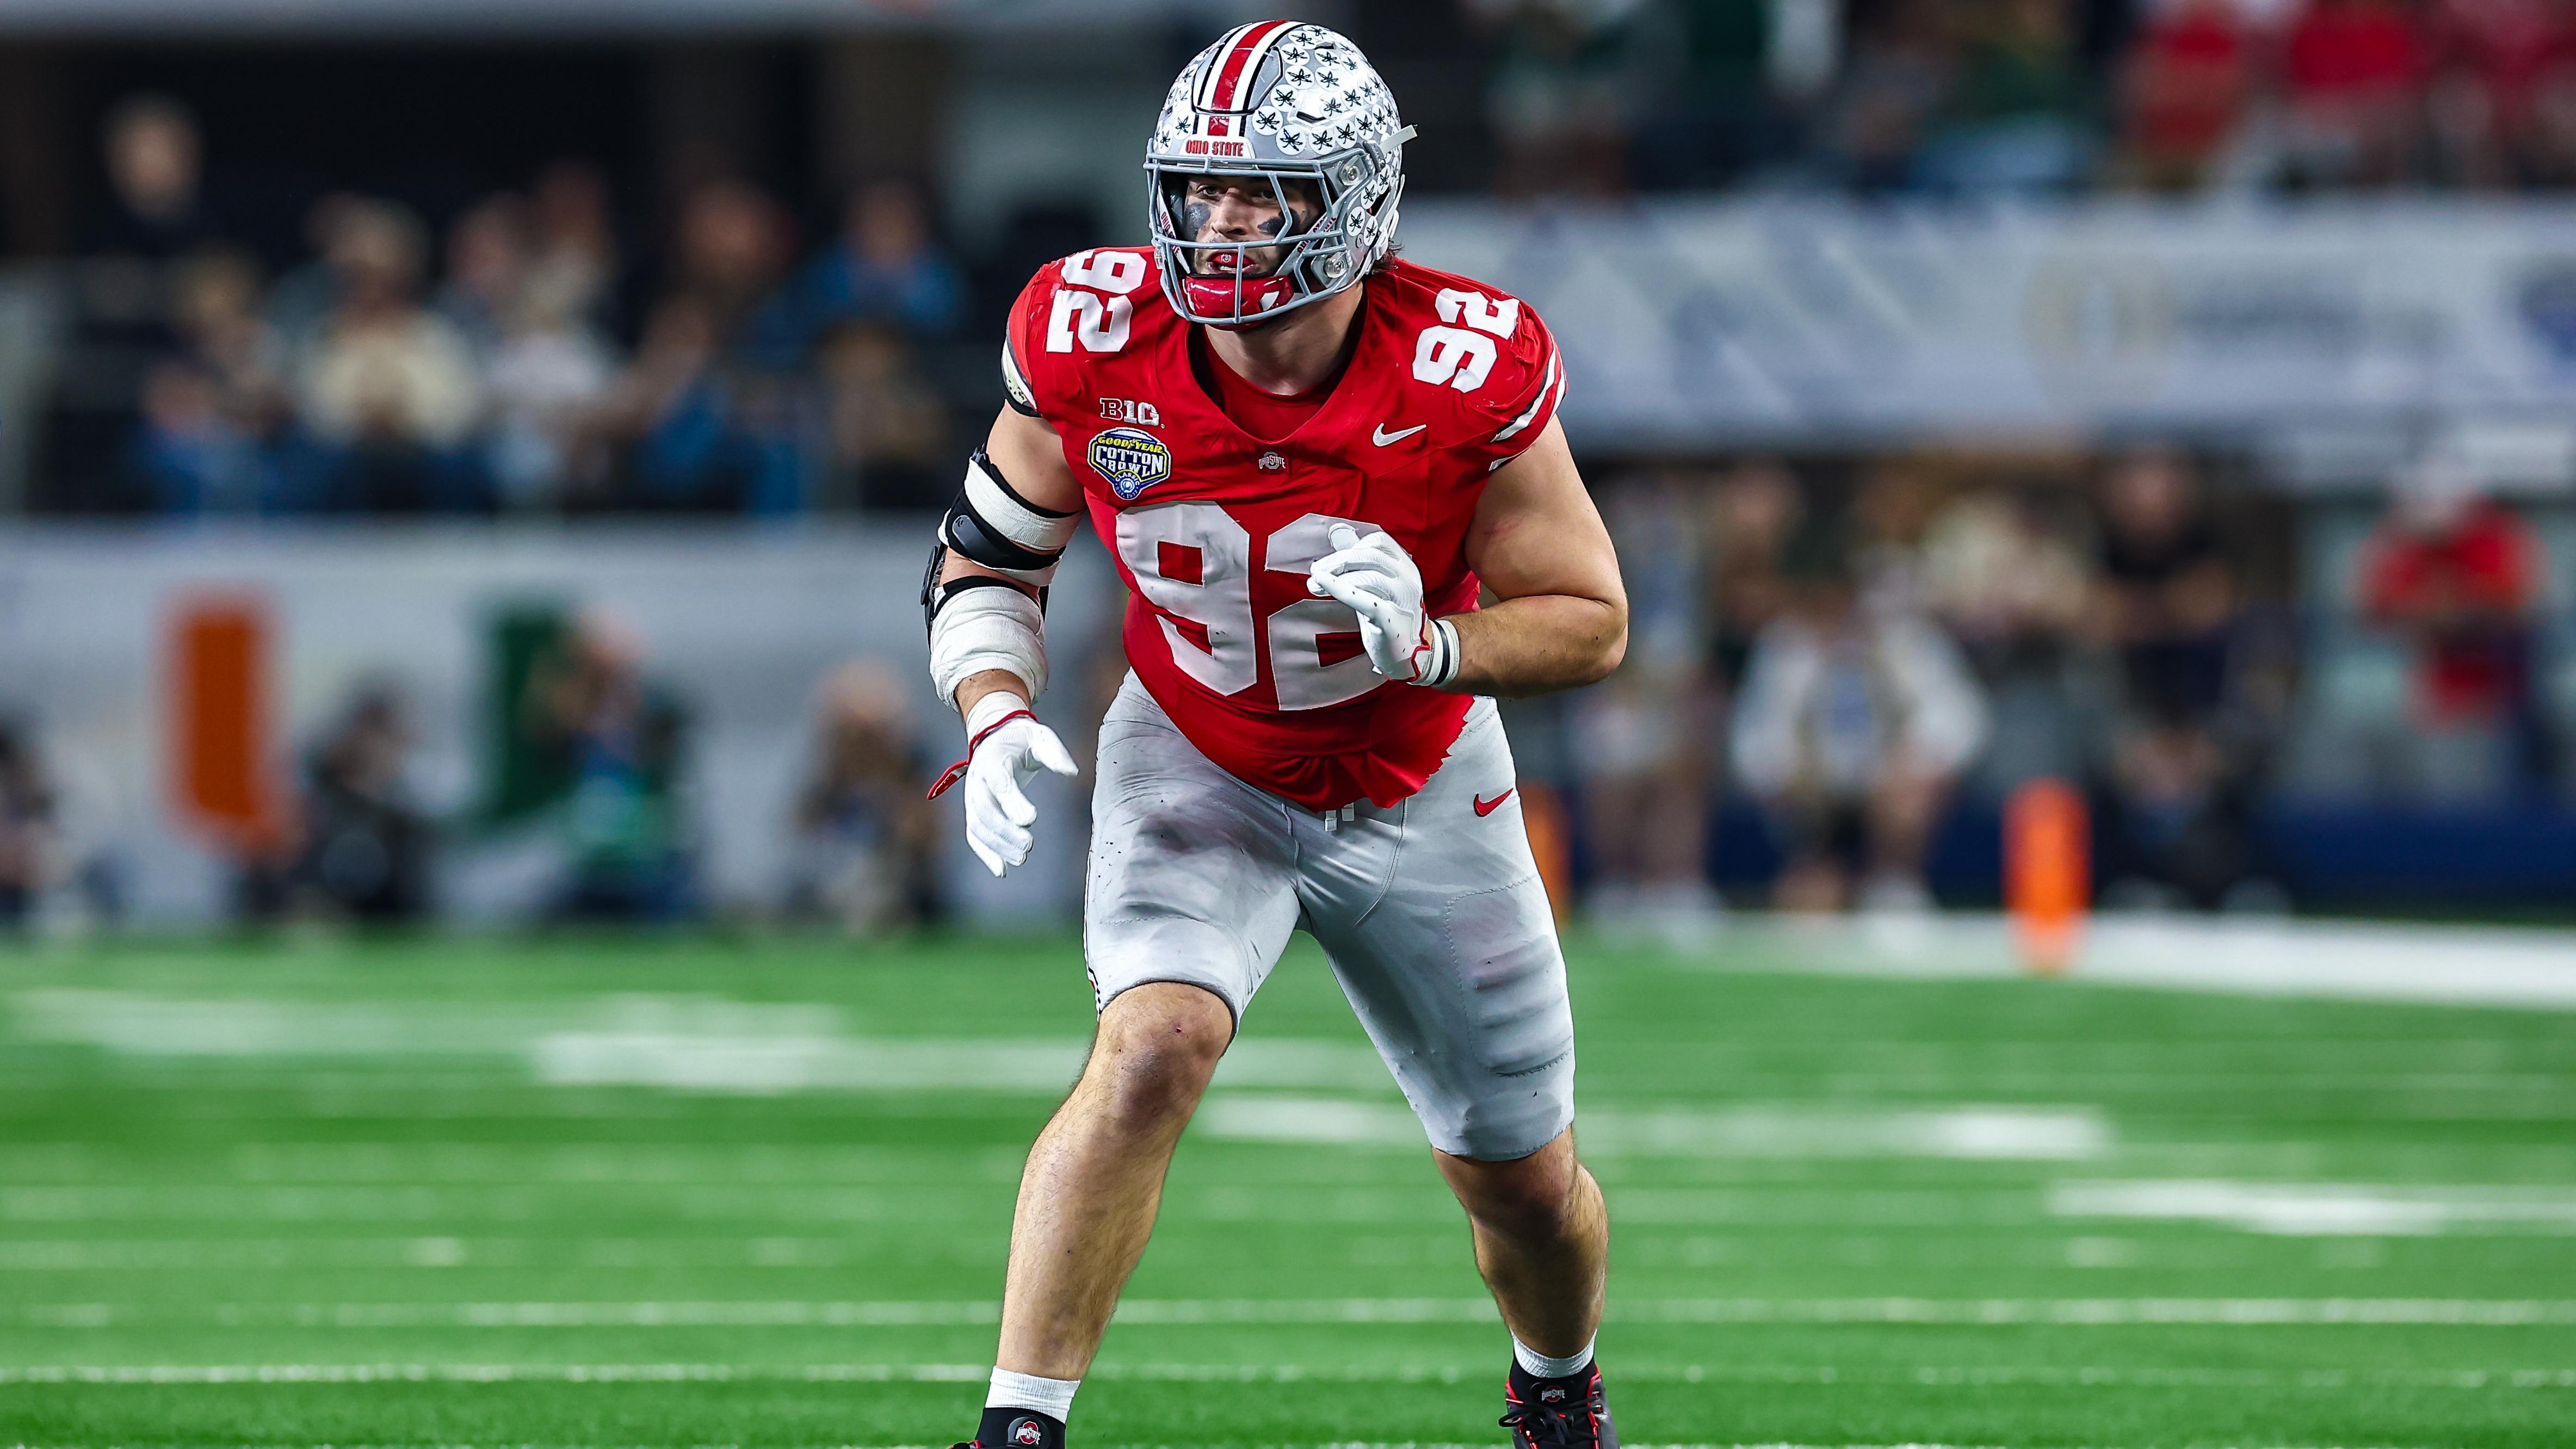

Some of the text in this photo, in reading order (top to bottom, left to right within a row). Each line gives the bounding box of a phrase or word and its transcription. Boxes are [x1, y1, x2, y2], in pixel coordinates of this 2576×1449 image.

[1185, 140, 1244, 157] OHIO STATE
[1161, 212, 1171, 231] OHIO
[1046, 250, 1147, 353] 92
[1412, 287, 1521, 393] 92
[1098, 436, 1164, 454] GOODYEAR
[1096, 445, 1164, 475] COTTON
[1107, 460, 1150, 478] BOWL
[1258, 455, 1286, 469] OHIO STATE
[1115, 472, 1140, 486] CLASSIC
[1116, 500, 1413, 711] 92
